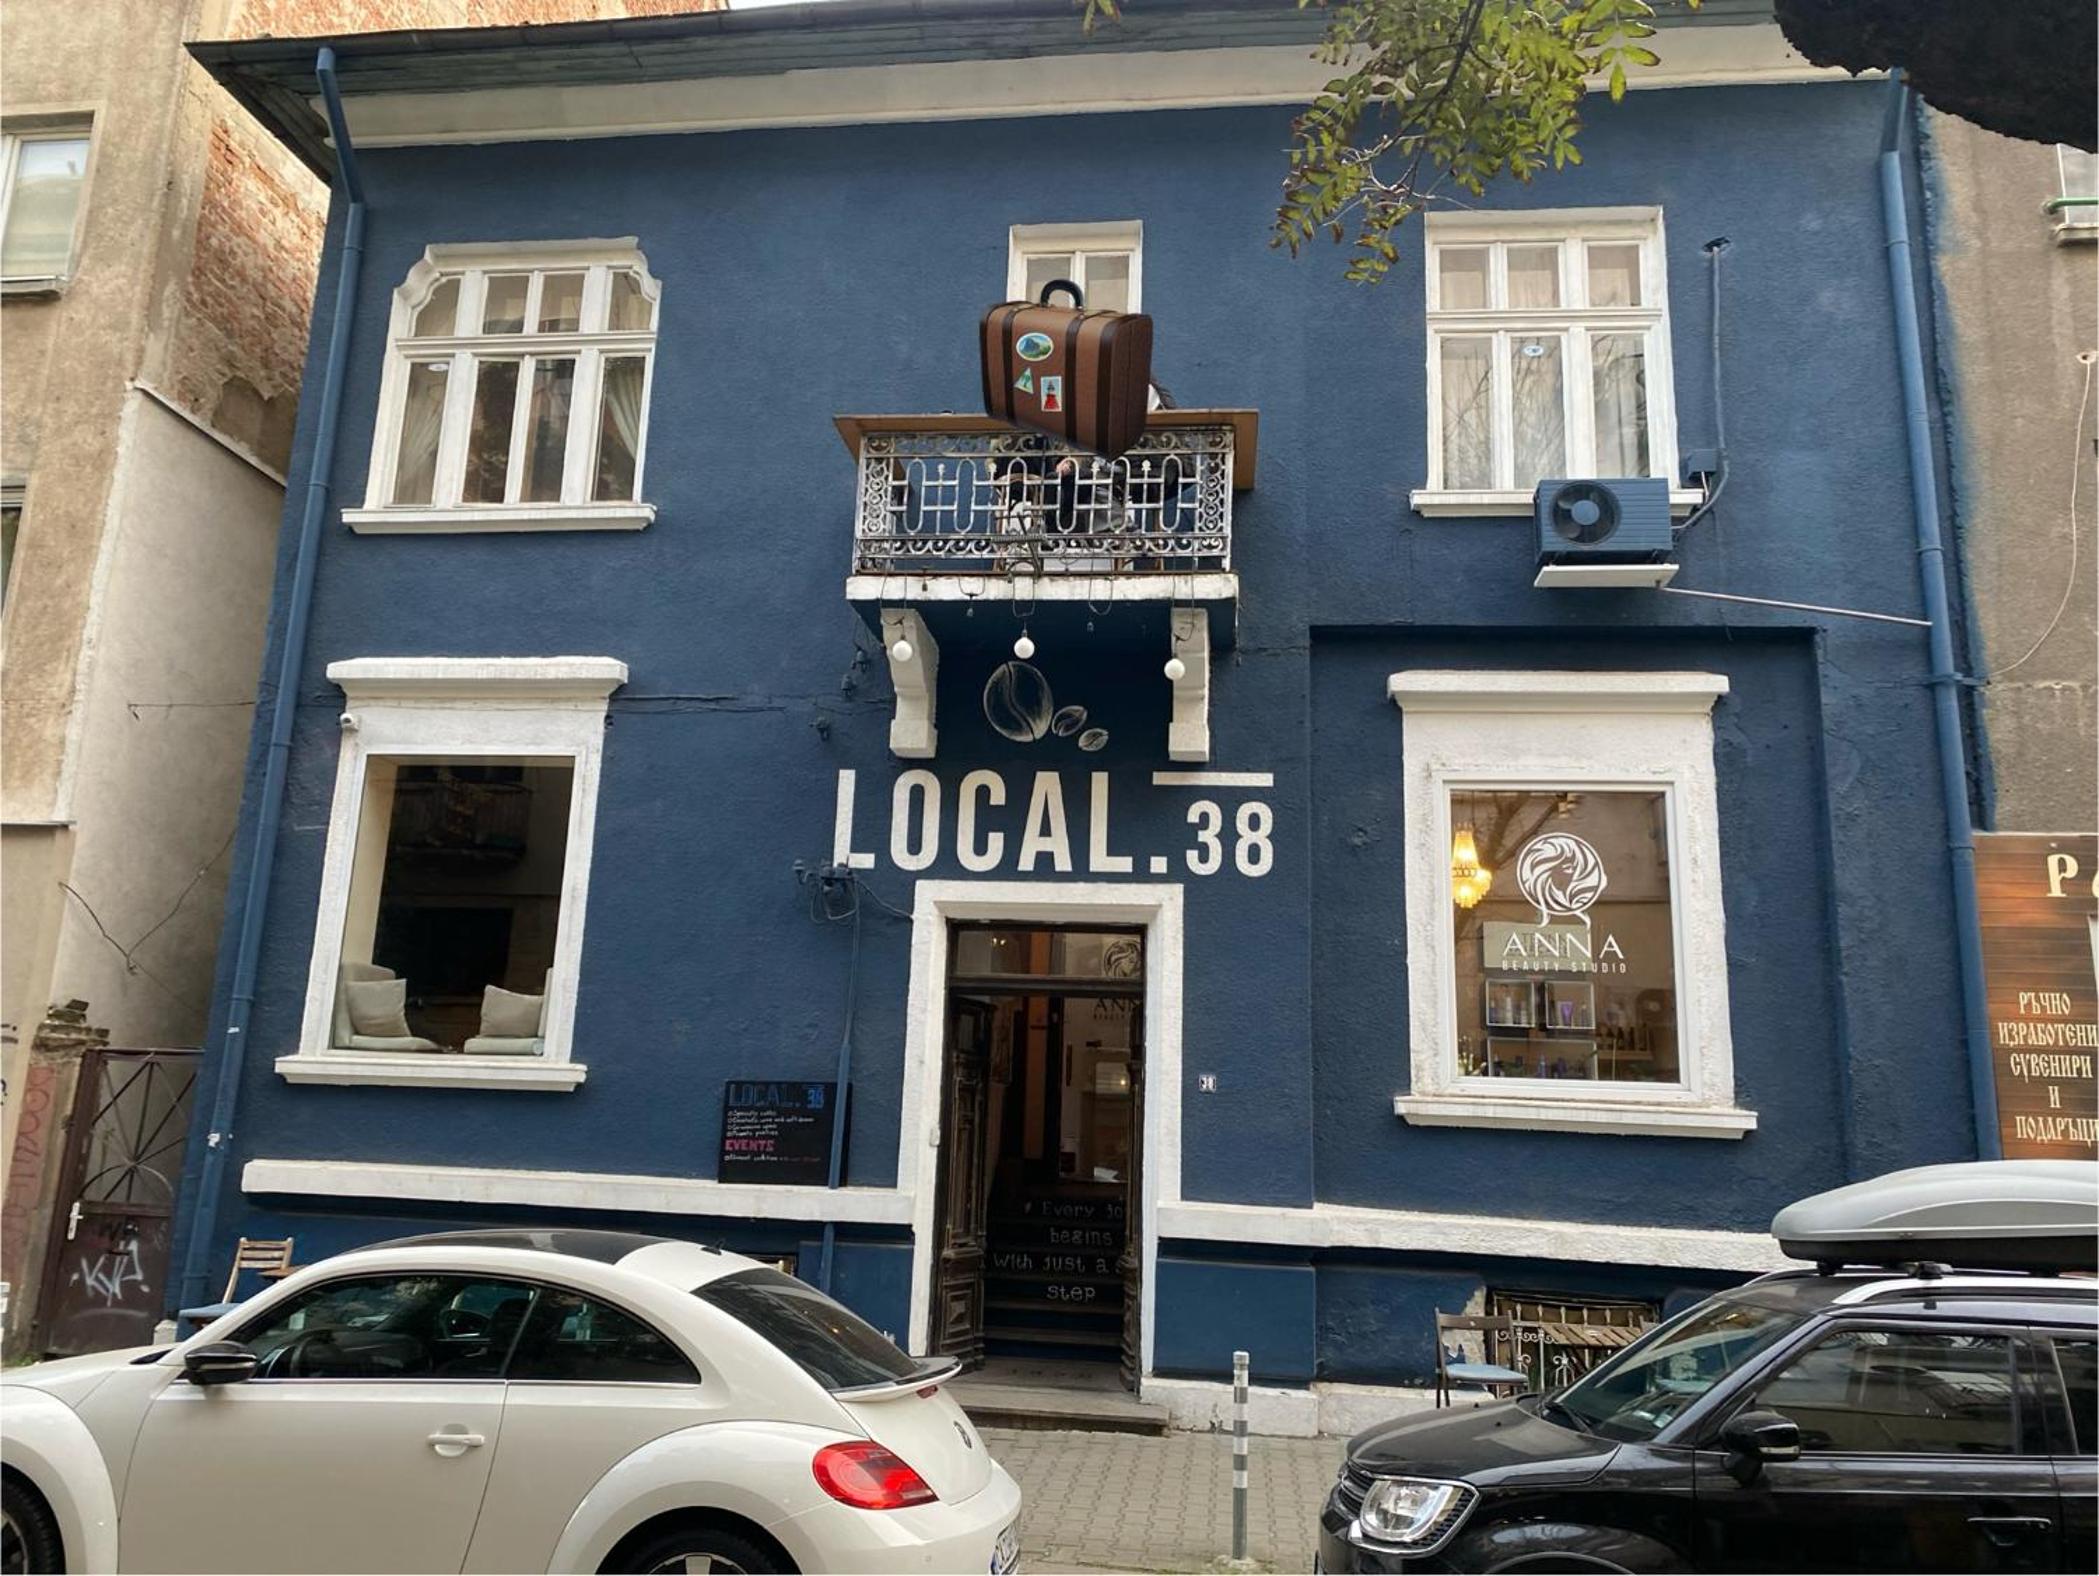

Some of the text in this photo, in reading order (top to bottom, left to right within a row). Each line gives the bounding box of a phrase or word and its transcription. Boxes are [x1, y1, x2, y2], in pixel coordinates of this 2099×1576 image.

[1503, 932, 1625, 959] ANNA
[1502, 960, 1627, 973] BEAUTY STUDIO
[2019, 992, 2071, 1016] РЪЧНО
[1998, 1022, 2098, 1048] ИЗРАБОТЕНИ
[2010, 1053, 2094, 1083] СУВЕНИРИ
[2048, 1085, 2061, 1108] И
[725, 1139, 775, 1151] EVENTS
[1042, 1201, 1095, 1218] Every
[1050, 1227, 1113, 1246] begins
[1042, 1255, 1086, 1273] just
